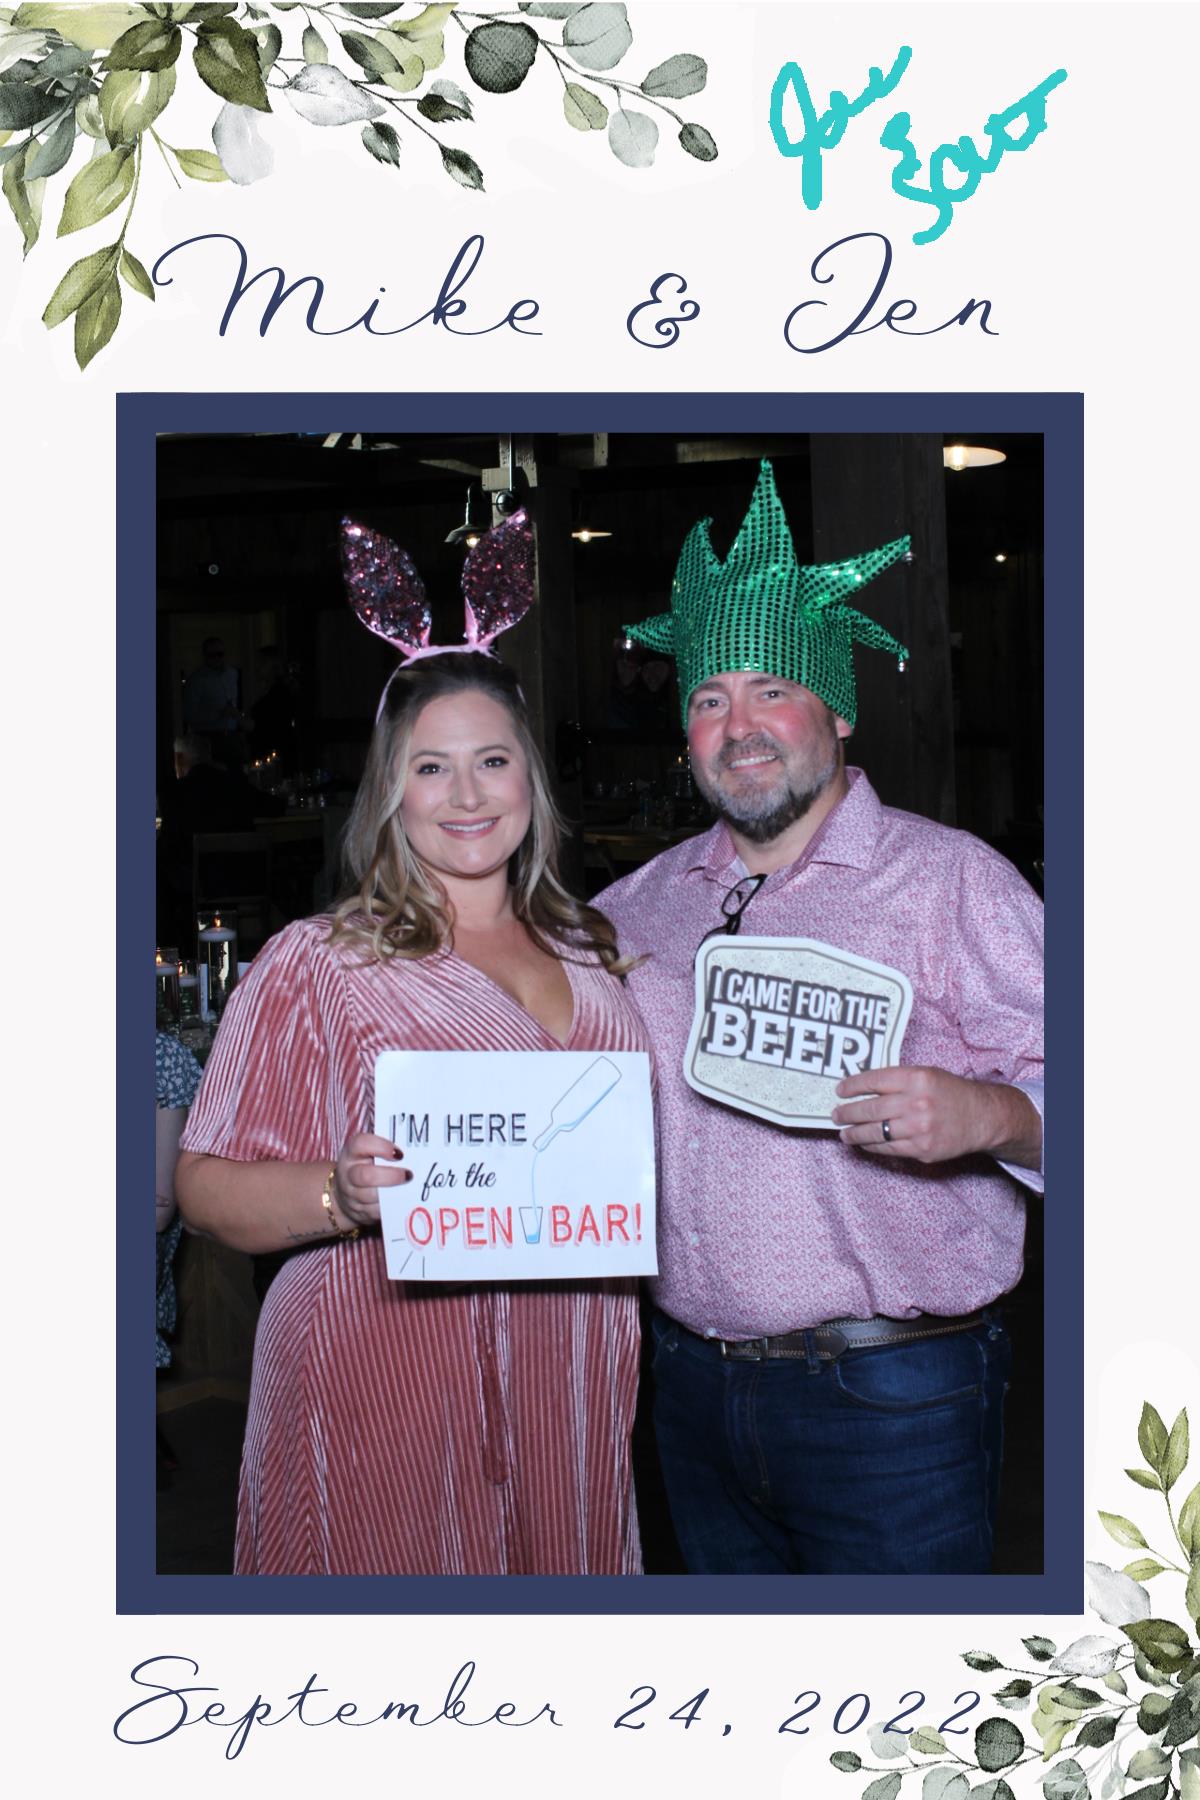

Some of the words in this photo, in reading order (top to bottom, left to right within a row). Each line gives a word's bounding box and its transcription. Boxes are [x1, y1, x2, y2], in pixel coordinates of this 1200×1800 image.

[725, 971, 792, 1013] CAME
[795, 984, 841, 1023] FOR
[844, 993, 890, 1032] THE
[391, 1112, 430, 1143] I'M
[446, 1112, 528, 1144] HERE
[421, 1162, 457, 1202] for
[464, 1162, 497, 1188] the
[407, 1206, 514, 1247] OPEN
[550, 1203, 643, 1246] BAR!
